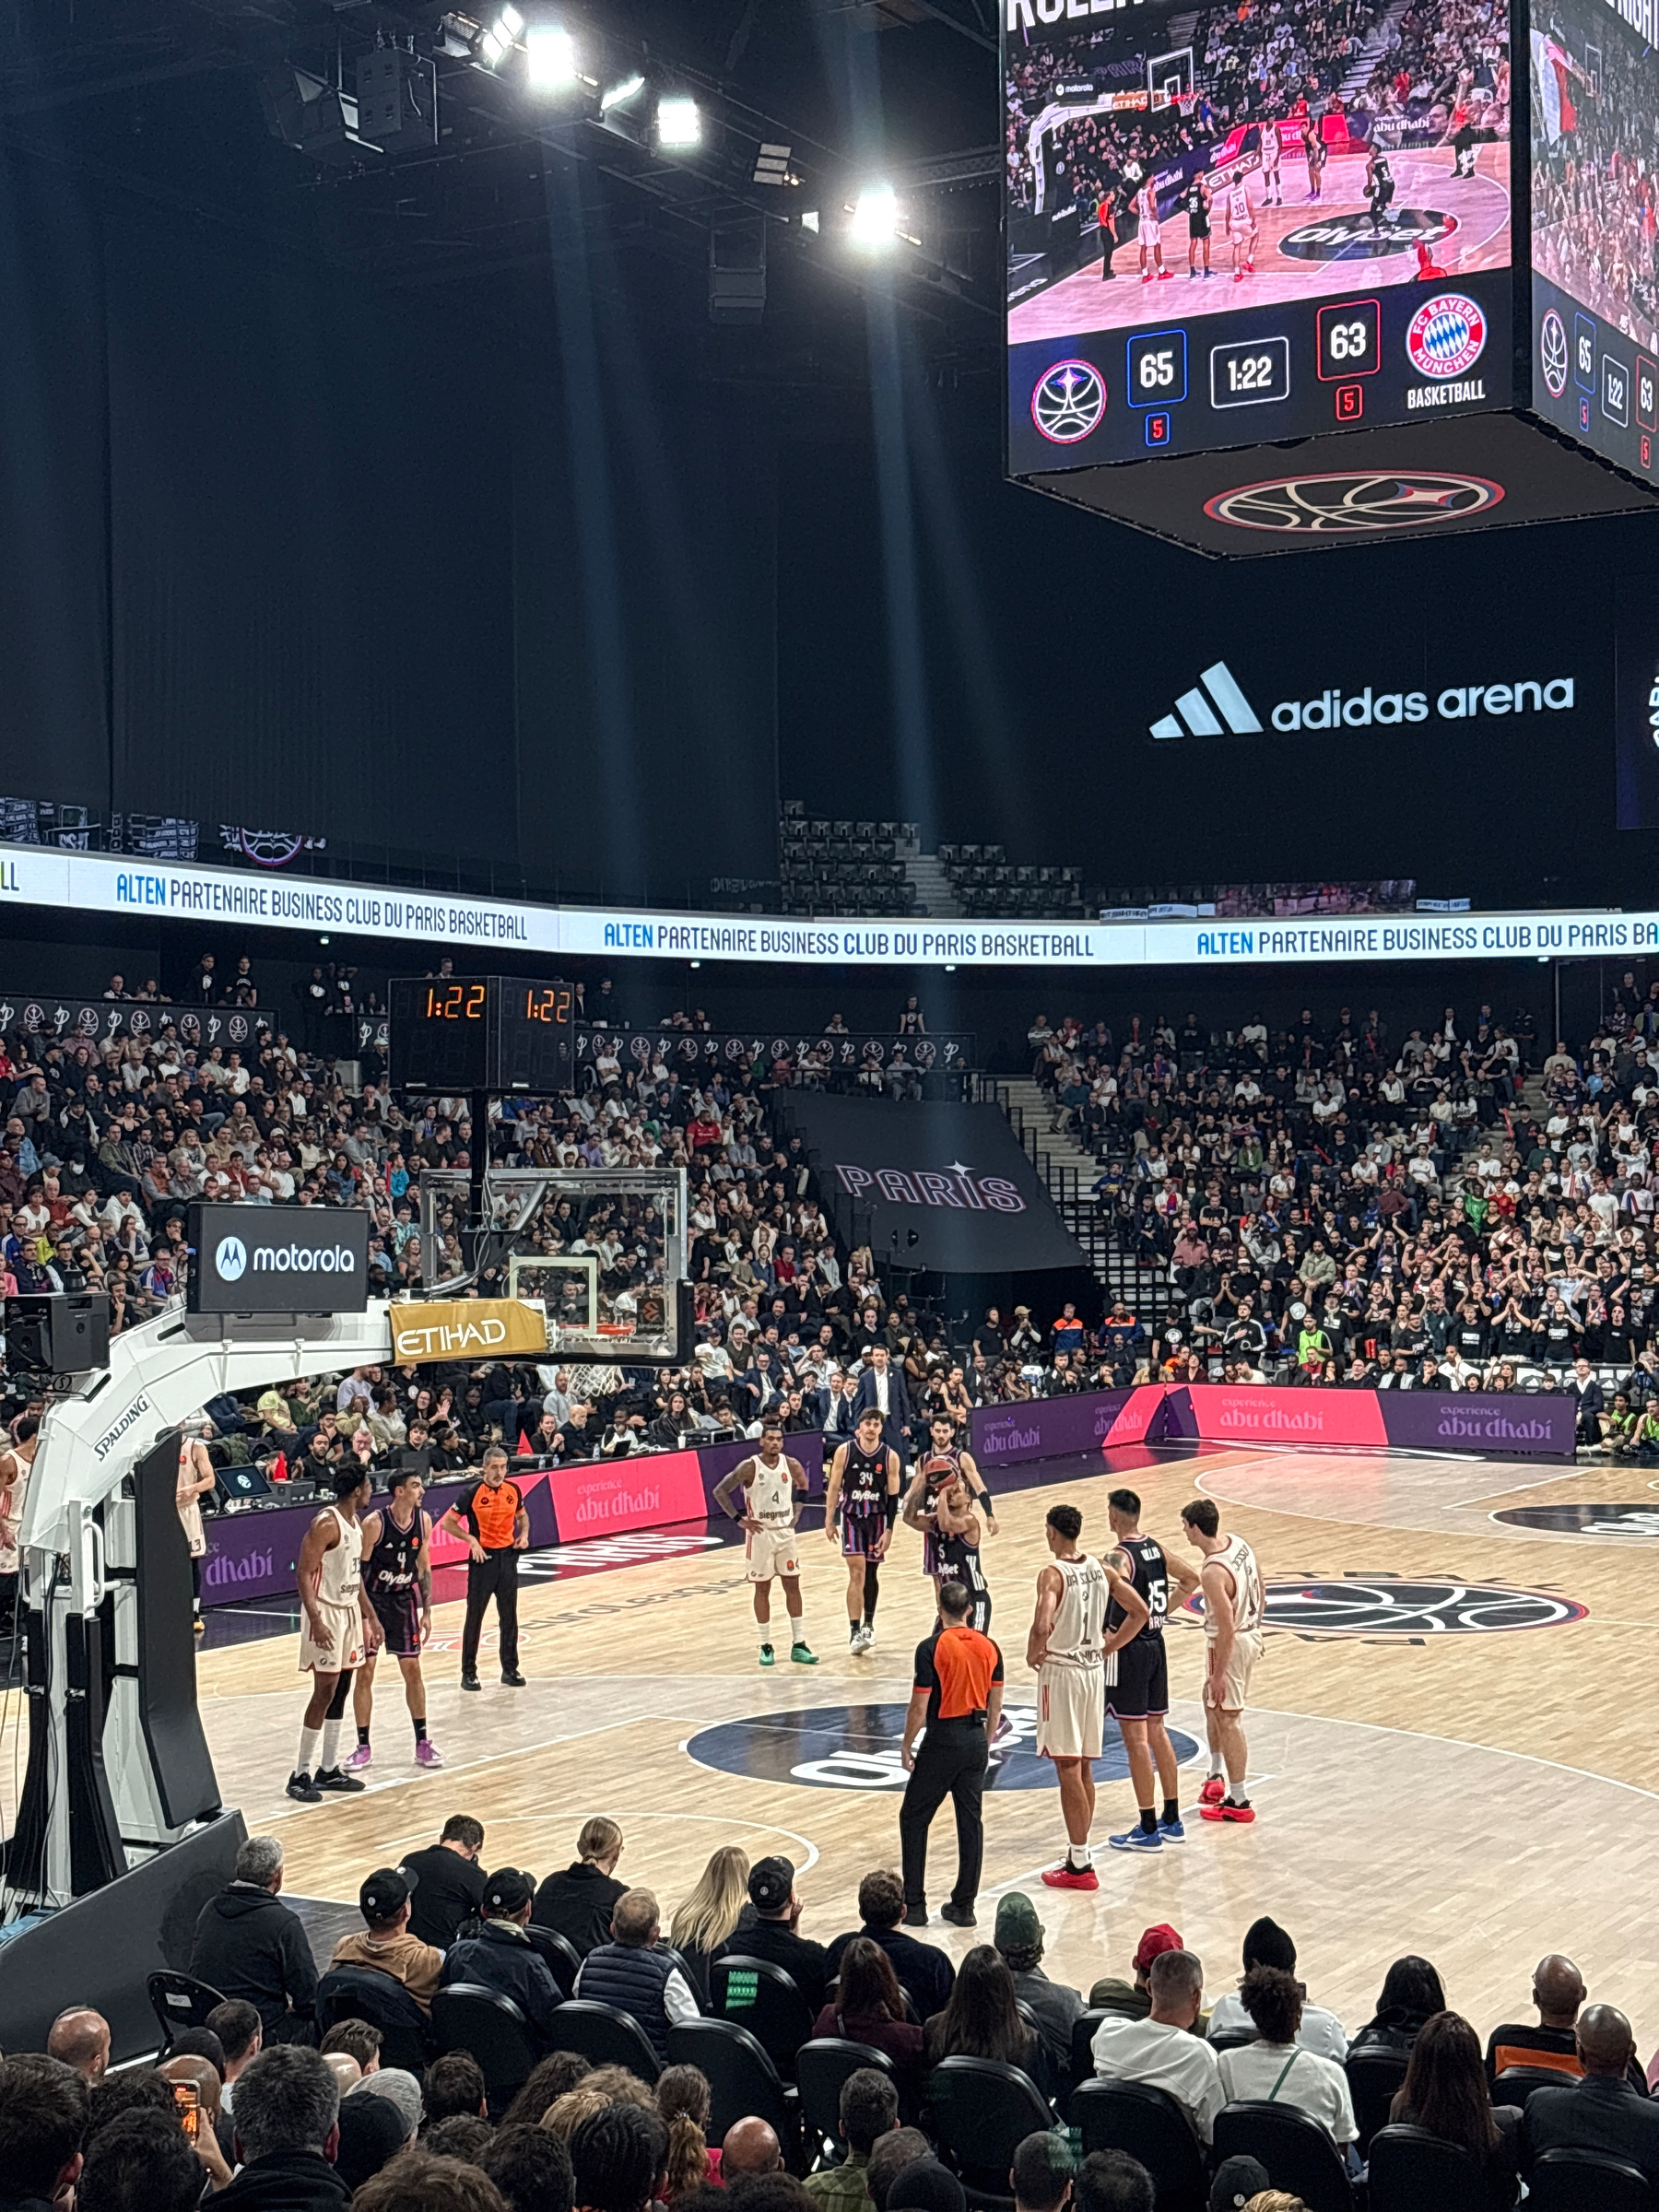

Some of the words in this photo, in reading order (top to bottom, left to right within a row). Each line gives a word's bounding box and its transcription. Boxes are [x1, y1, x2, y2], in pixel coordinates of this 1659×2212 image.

[1413, 313, 1429, 335] FC
[1428, 299, 1480, 327] BAYERN
[1330, 322, 1366, 359] 63
[1579, 335, 1591, 373] 65
[1140, 351, 1174, 388] 65
[1414, 340, 1479, 374] MÜNCHEN
[1228, 356, 1272, 391] 1:22
[1344, 392, 1355, 411] 5
[1407, 380, 1486, 410] BASKETBALL
[1607, 373, 1623, 410] 1:22
[1641, 377, 1653, 412] 63
[1152, 419, 1163, 439] 5
[1582, 406, 1588, 424] 5
[1643, 441, 1649, 460] 5
[1271, 687, 1428, 732] adidas
[1437, 677, 1574, 719] arena
[117, 874, 165, 905] ALTEN
[171, 877, 268, 917] PARTENAIRE
[272, 890, 342, 922] BUSINESS
[347, 899, 380, 925] CLUB
[385, 902, 402, 927] DU
[406, 905, 445, 932] PARIS
[448, 910, 528, 942] BASKETBALL
[605, 924, 653, 947] ALTEN
[658, 926, 756, 951] PARTENAIRE
[761, 931, 838, 954] BUSINESS
[844, 934, 888, 955] CLUB
[895, 934, 917, 955] DU
[924, 935, 976, 956] PARIS
[982, 935, 1093, 956] BASKETBALL
[1198, 932, 1253, 955] ALTEN
[1260, 930, 1377, 953] PARTENAIRE
[1383, 927, 1477, 950] BUSINESS
[1483, 926, 1531, 948] CLUB
[1537, 925, 1561, 947] DU
[1569, 924, 1627, 947] PARIS
[427, 985, 485, 1018] 1:22
[526, 990, 571, 1023] 1:22
[835, 1161, 1027, 1213] PARIS
[253, 1244, 354, 1272] motorola
[397, 1318, 506, 1356] ETIHAD
[1220, 1408, 1263, 1429] abu
[1264, 1409, 1324, 1431] dhabi
[1221, 1397, 1277, 1411] experience
[1440, 1406, 1501, 1418] experience
[94, 1394, 150, 1462] SPALDING
[1094, 1417, 1112, 1436] abu
[1112, 1409, 1143, 1432] dhabi
[1438, 1417, 1479, 1437] abu
[1485, 1418, 1552, 1441] dhabi
[983, 1434, 1006, 1454] abu
[1007, 1426, 1041, 1450] dhabi
[577, 1478, 623, 1495] experience
[859, 1472, 874, 1486] 34
[576, 1498, 611, 1523] abu
[612, 1485, 660, 1515] dhabi
[772, 1490, 779, 1504] 4
[852, 1489, 880, 1502] OlyBet
[206, 1547, 274, 1586] dhabi
[397, 1551, 406, 1569] 4
[938, 1544, 946, 1559] 5
[1066, 1574, 1079, 1587] DA
[1079, 1611, 1092, 1645] 1
